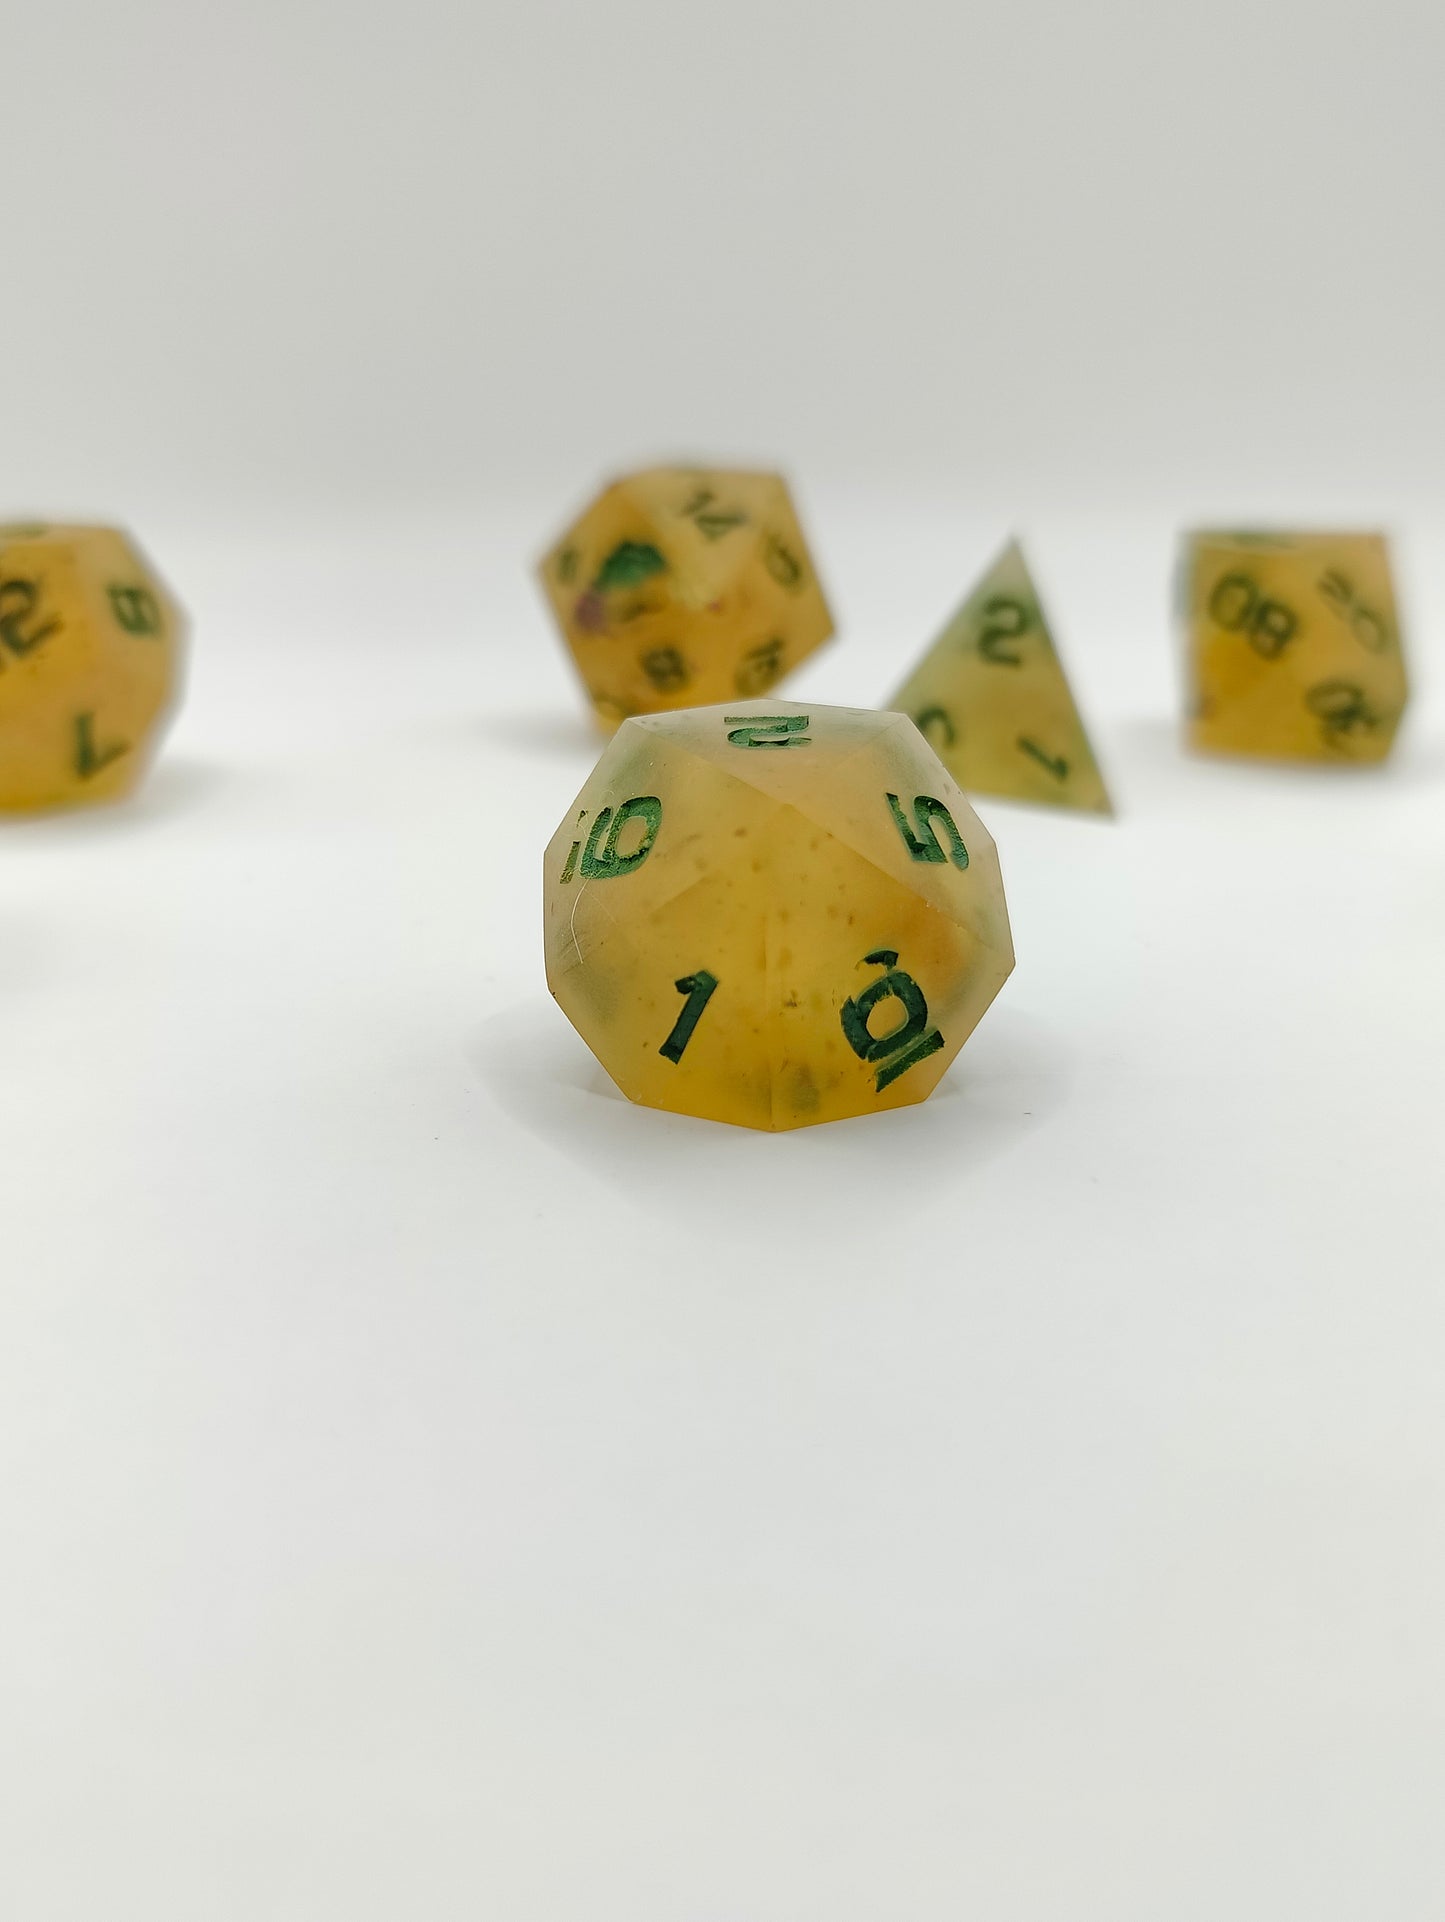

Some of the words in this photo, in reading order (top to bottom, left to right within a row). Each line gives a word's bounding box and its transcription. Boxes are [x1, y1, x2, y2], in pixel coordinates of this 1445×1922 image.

[978, 597, 1028, 668] 2
[886, 792, 970, 872] 5
[658, 969, 719, 1064] 1
